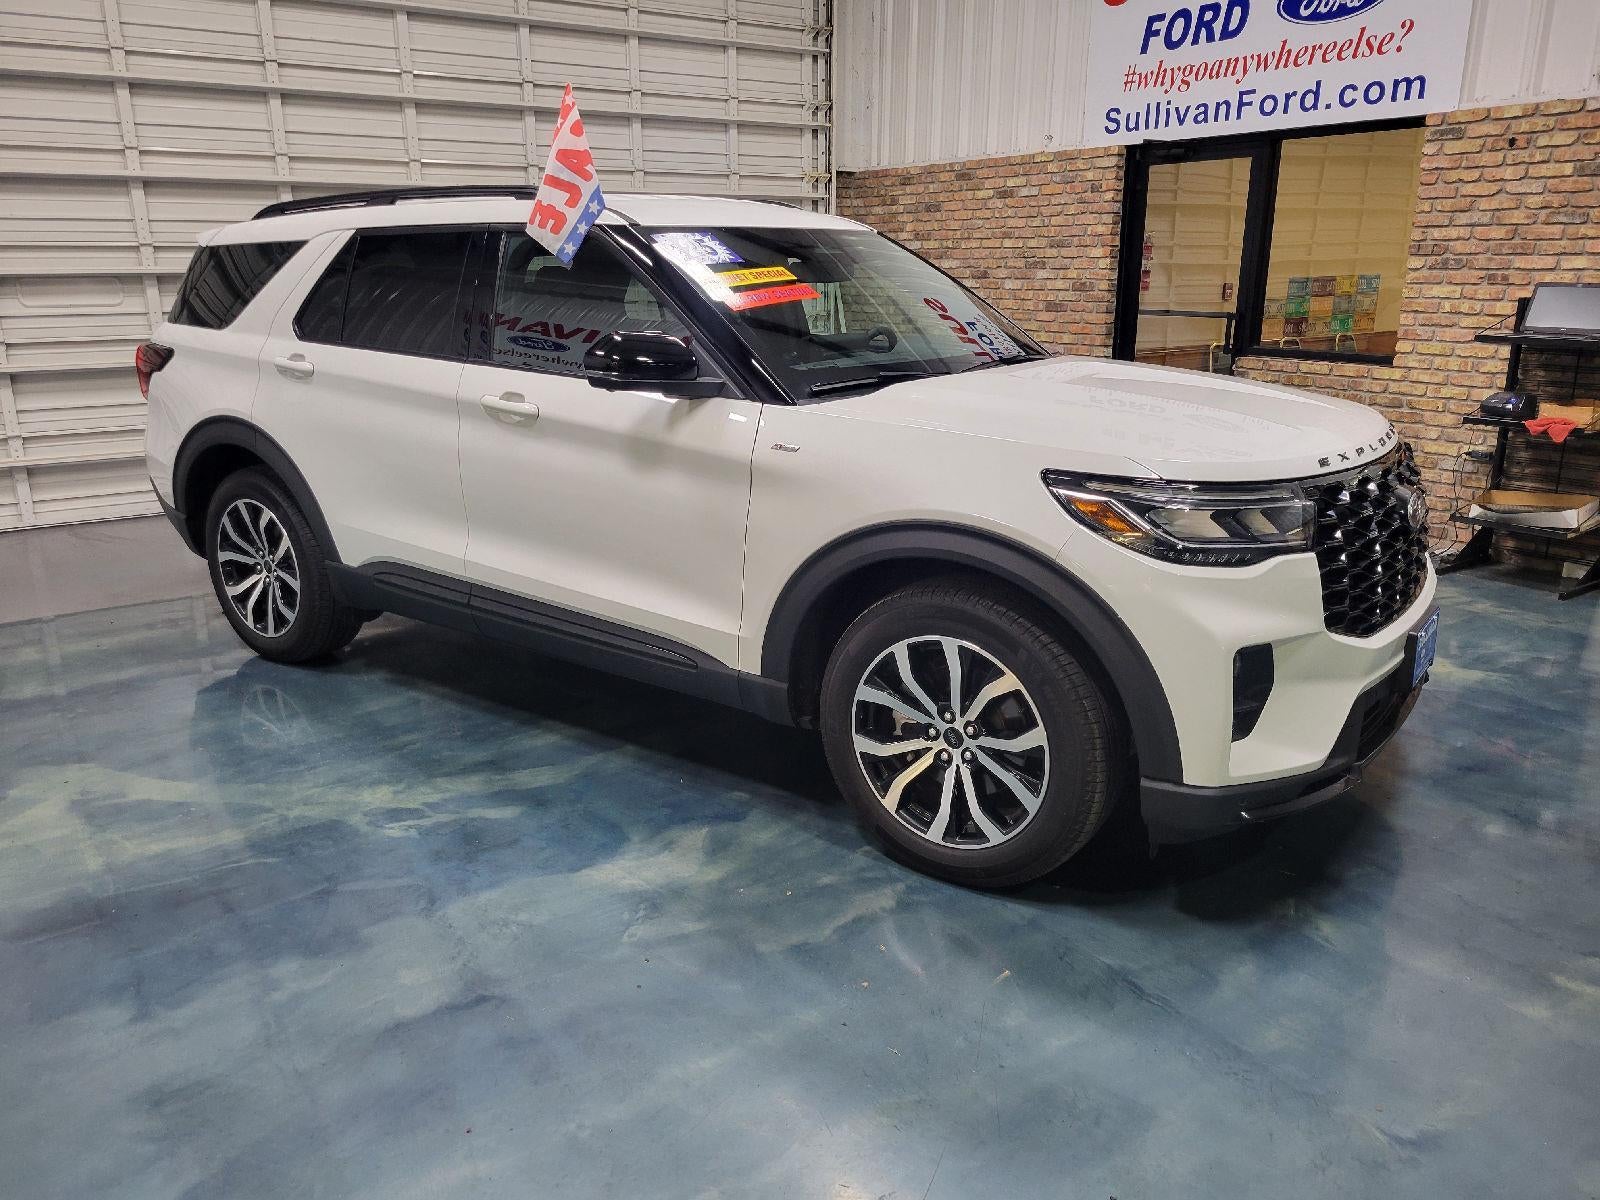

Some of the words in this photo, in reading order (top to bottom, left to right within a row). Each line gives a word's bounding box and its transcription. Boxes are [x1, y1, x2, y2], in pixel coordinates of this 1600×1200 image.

[1123, 19, 1415, 95] #whygoanywhereelse?
[1140, 0, 1250, 54] FORD
[1104, 74, 1427, 135] SullivanFord.com
